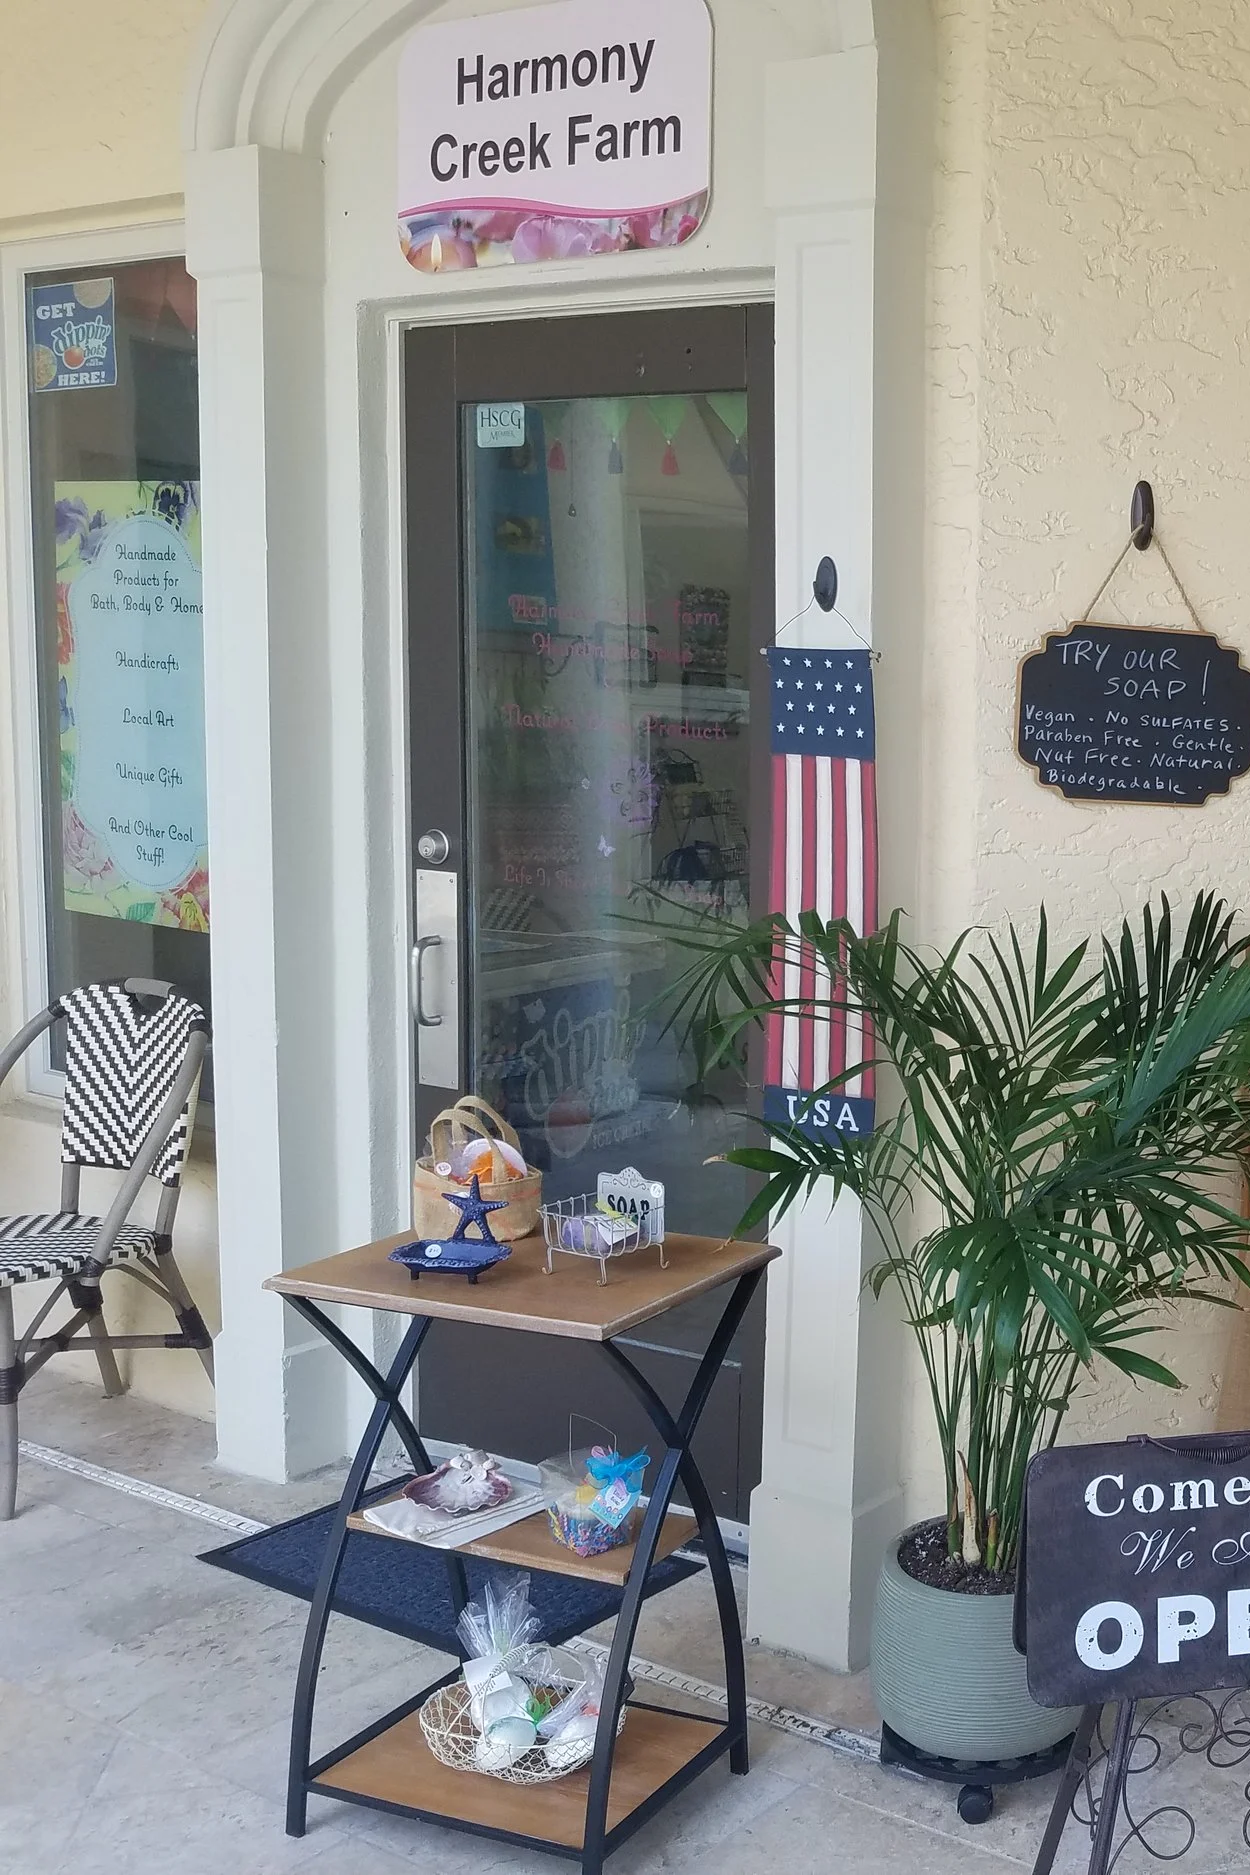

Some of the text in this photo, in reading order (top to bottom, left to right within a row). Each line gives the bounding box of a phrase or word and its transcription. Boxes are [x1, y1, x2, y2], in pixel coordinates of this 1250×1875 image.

[457, 39, 655, 105] Harmony
[431, 114, 681, 182] Creek Farm
[36, 302, 75, 320] GET
[58, 371, 105, 386] HERE!
[480, 408, 520, 429] HSCG
[115, 544, 176, 561] Handmade
[113, 569, 179, 591] Products for
[90, 593, 120, 611] Bath,
[123, 595, 151, 616] Body
[155, 596, 164, 612] &
[115, 650, 179, 674] Handicrafts
[1056, 640, 1181, 672] TRY OUR
[122, 708, 175, 727] Local Art
[1025, 704, 1075, 727] Vegan
[1106, 711, 1128, 726] No
[1024, 726, 1093, 744] Paraben
[1104, 731, 1143, 748] Free
[1035, 748, 1075, 765] Nut
[116, 762, 183, 788] Unique Gifts
[1047, 769, 1187, 795] Biodegradable
[108, 816, 194, 843] And Other Cool
[136, 845, 165, 867] Stuff!
[786, 1095, 859, 1132] USA
[607, 1194, 650, 1220] SOAP
[1120, 1526, 1196, 1575] We
